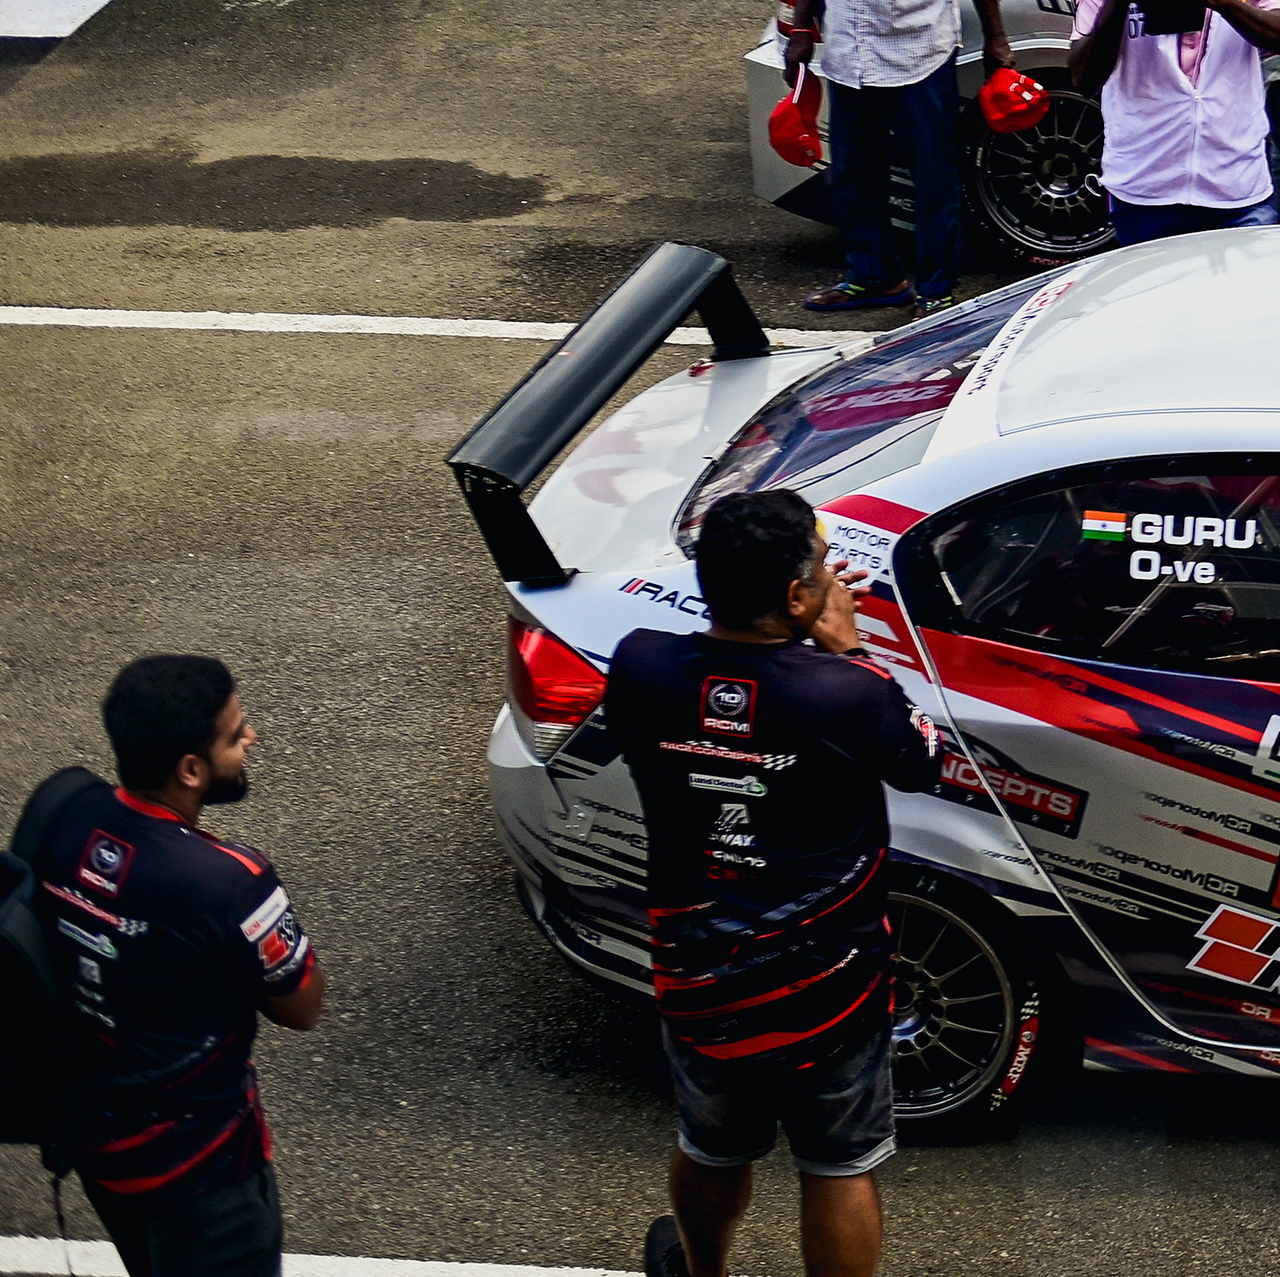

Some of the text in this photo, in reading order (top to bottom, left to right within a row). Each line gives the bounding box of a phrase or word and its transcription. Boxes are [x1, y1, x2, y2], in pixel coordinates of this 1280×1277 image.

[835, 523, 891, 551] MOTOR
[1131, 513, 1257, 549] GURU
[829, 542, 882, 570] PARTS
[1129, 549, 1216, 584] O-ve
[716, 692, 740, 704] 10
[704, 717, 750, 733] RCM
[1007, 1044, 1031, 1083] MRF
